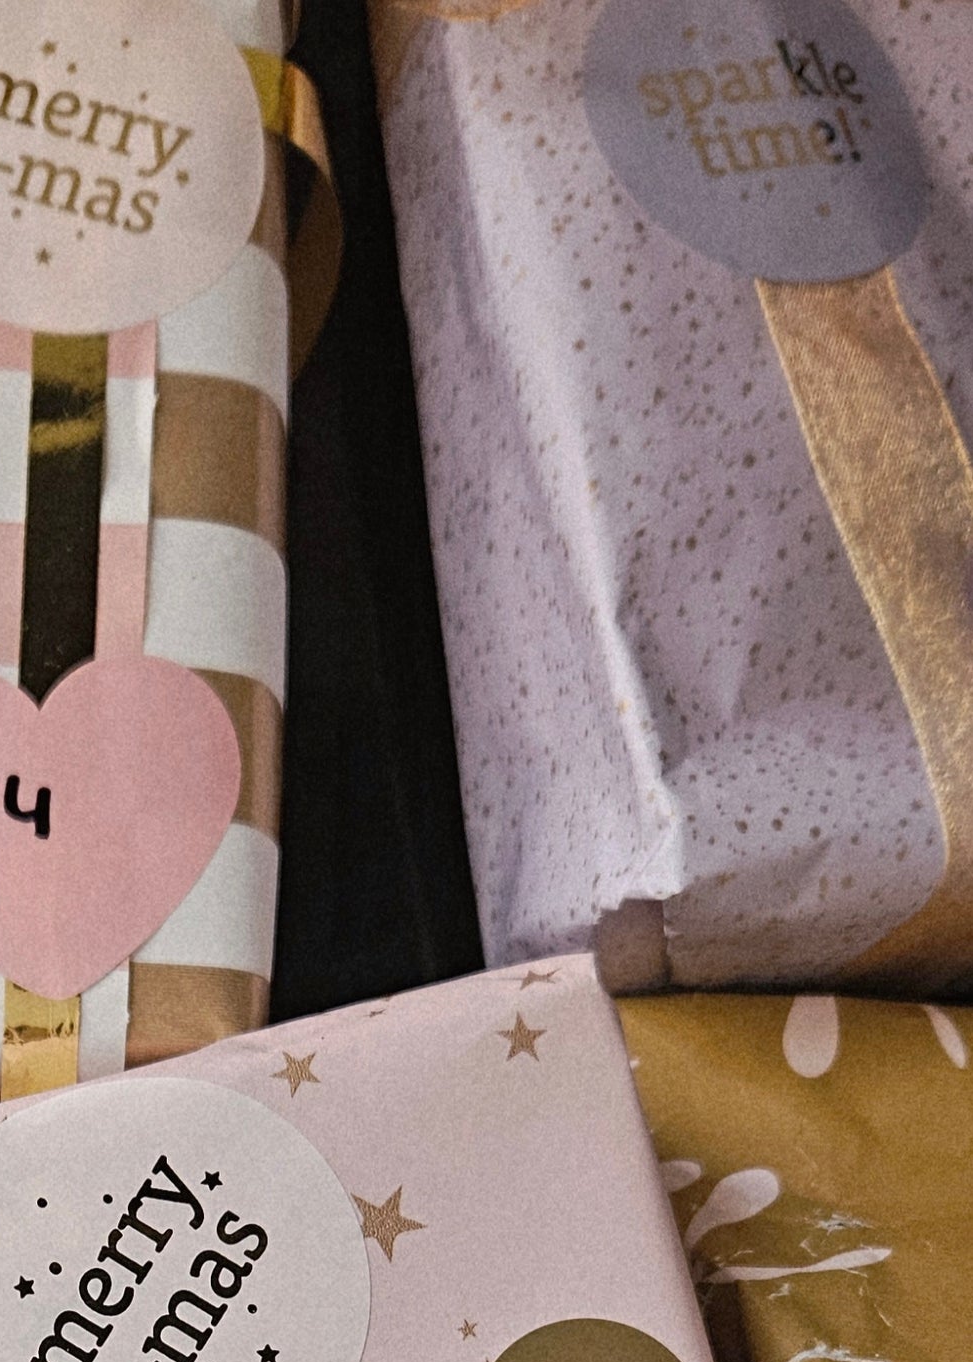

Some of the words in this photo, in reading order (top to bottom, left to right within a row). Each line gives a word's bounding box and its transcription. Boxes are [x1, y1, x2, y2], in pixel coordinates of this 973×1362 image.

[638, 39, 864, 126] sparkle
[691, 107, 862, 177] time!
[4, 775, 51, 840] 4
